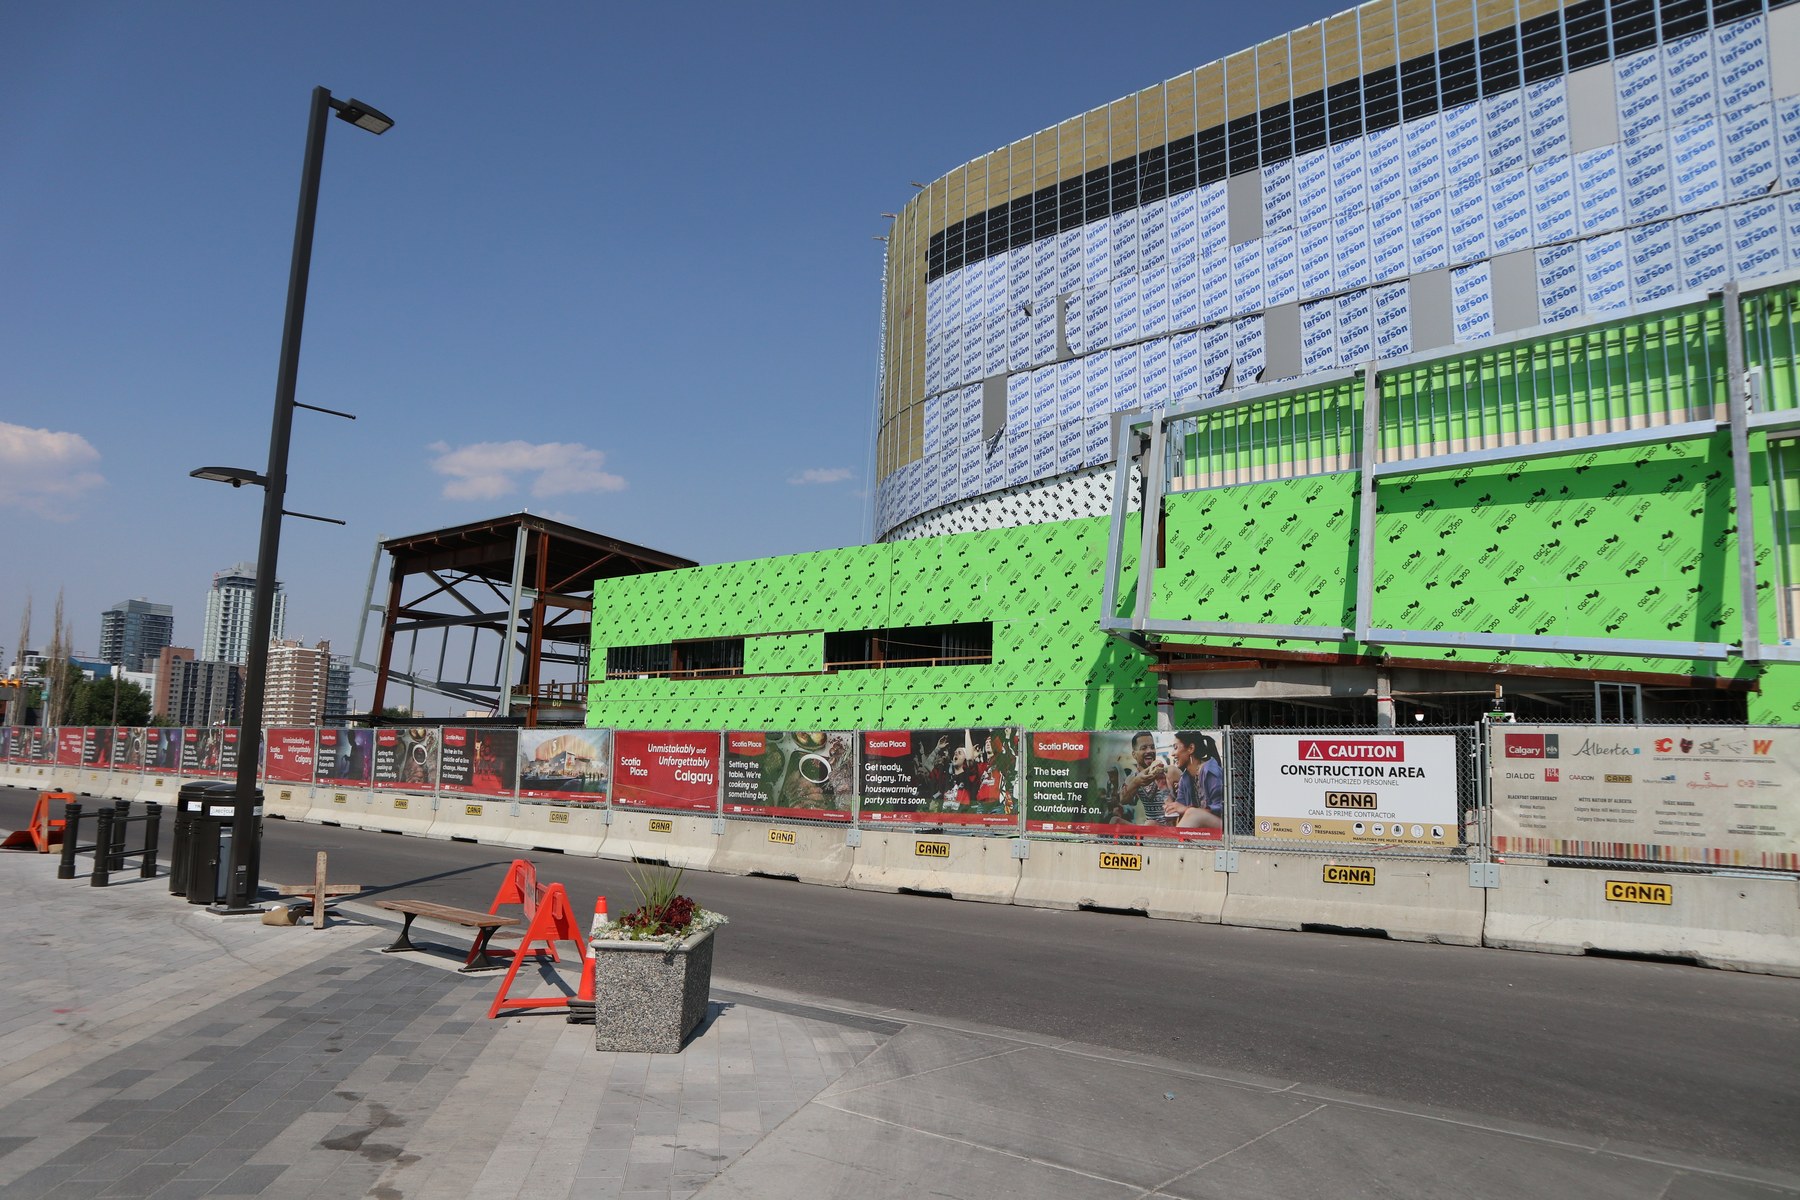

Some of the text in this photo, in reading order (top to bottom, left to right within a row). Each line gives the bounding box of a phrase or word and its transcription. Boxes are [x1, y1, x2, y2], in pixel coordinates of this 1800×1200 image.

[1721, 38, 1762, 64] larson
[1621, 74, 1657, 98] larson
[1670, 72, 1709, 96] larson
[1530, 96, 1563, 118] larson
[1406, 120, 1436, 140] larson
[1727, 119, 1768, 143] larson
[1626, 144, 1663, 168] larson
[1676, 140, 1714, 163] larson
[1370, 155, 1399, 175] larson
[1582, 188, 1617, 209] larson
[1734, 204, 1775, 227] larson
[1374, 226, 1402, 245] larson
[1035, 251, 1054, 268] larson
[1413, 244, 1444, 264] larson
[1684, 244, 1723, 267] larson
[1540, 265, 1575, 288] larson
[1587, 261, 1622, 281] larson
[1455, 275, 1487, 294] larson
[1110, 323, 1136, 342] larson
[1111, 351, 1136, 368] larson
[1280, 521, 1291, 533] CGC
[1326, 516, 1336, 528] CGC
[1597, 544, 1609, 556] CGC
[1479, 553, 1490, 565] CGC
[1288, 568, 1298, 579] CGC
[1577, 599, 1590, 611] CGC
[1637, 596, 1650, 608] CGC
[648, 744, 695, 754] Unmistakably
[1038, 742, 1061, 751] Scotia
[1328, 745, 1396, 758] CAUTION
[1509, 746, 1540, 756] Calgary
[1572, 738, 1632, 756] Alberta
[621, 757, 640, 766] Scotia
[659, 756, 709, 768] Unforgettably
[729, 761, 747, 770] Setting
[865, 763, 902, 772] Get ready,
[630, 767, 648, 776] Place
[675, 770, 713, 785] Calgary
[729, 771, 744, 779] table.
[1034, 768, 1069, 776] The best
[1281, 765, 1425, 778] CONSTRUCTION AREA
[729, 780, 749, 789] cooking
[865, 774, 895, 783] Calgary.
[1034, 780, 1072, 788] moments
[729, 790, 768, 800] something big.
[865, 785, 918, 794] housewarming
[864, 797, 884, 805] party
[1034, 792, 1081, 801] shared. The
[1329, 794, 1374, 807] CANA
[1034, 804, 1078, 813] countdown
[1081, 806, 1086, 814] is
[651, 822, 669, 831] CANA
[771, 832, 793, 842] CANA
[919, 845, 946, 854] CANA
[1104, 856, 1137, 867] CANA
[1328, 868, 1370, 881] CANA
[1613, 885, 1665, 900] CANA
